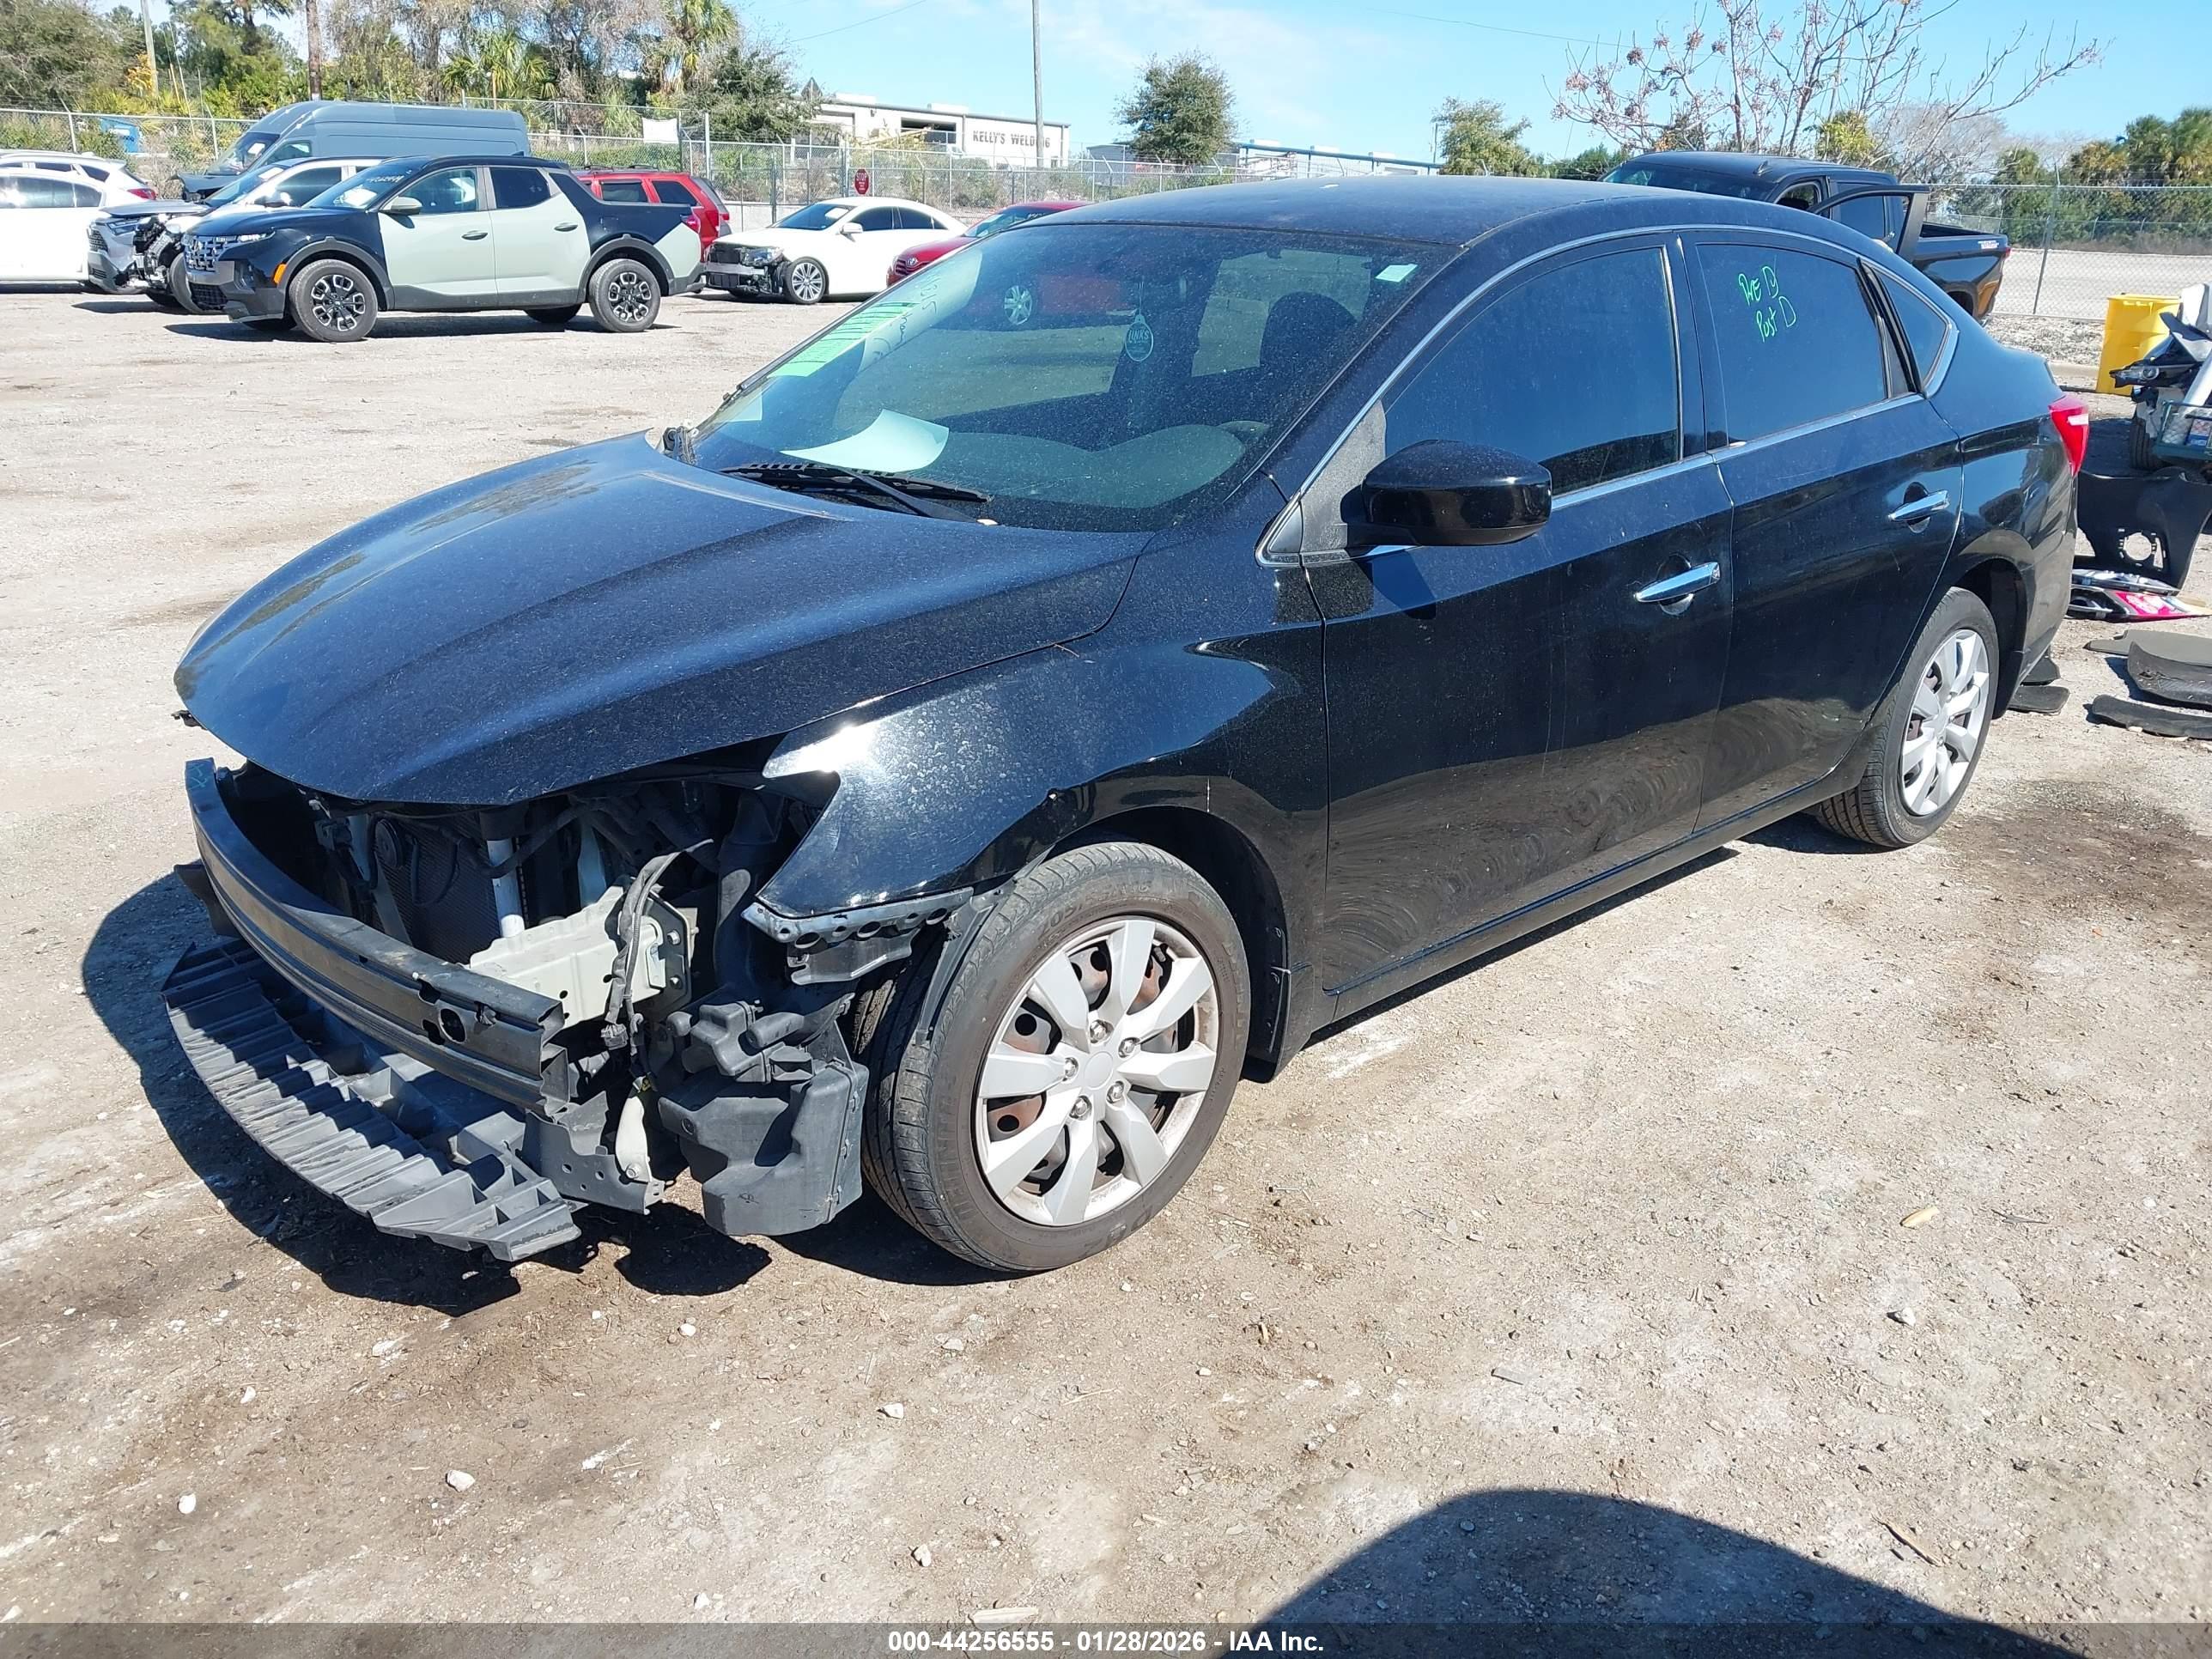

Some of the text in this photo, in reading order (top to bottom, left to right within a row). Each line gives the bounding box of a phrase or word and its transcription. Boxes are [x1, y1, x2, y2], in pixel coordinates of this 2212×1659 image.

[973, 130, 1050, 148] KELLY'S WELDG
[856, 172, 866, 181] STOP
[1778, 295, 1796, 328] D
